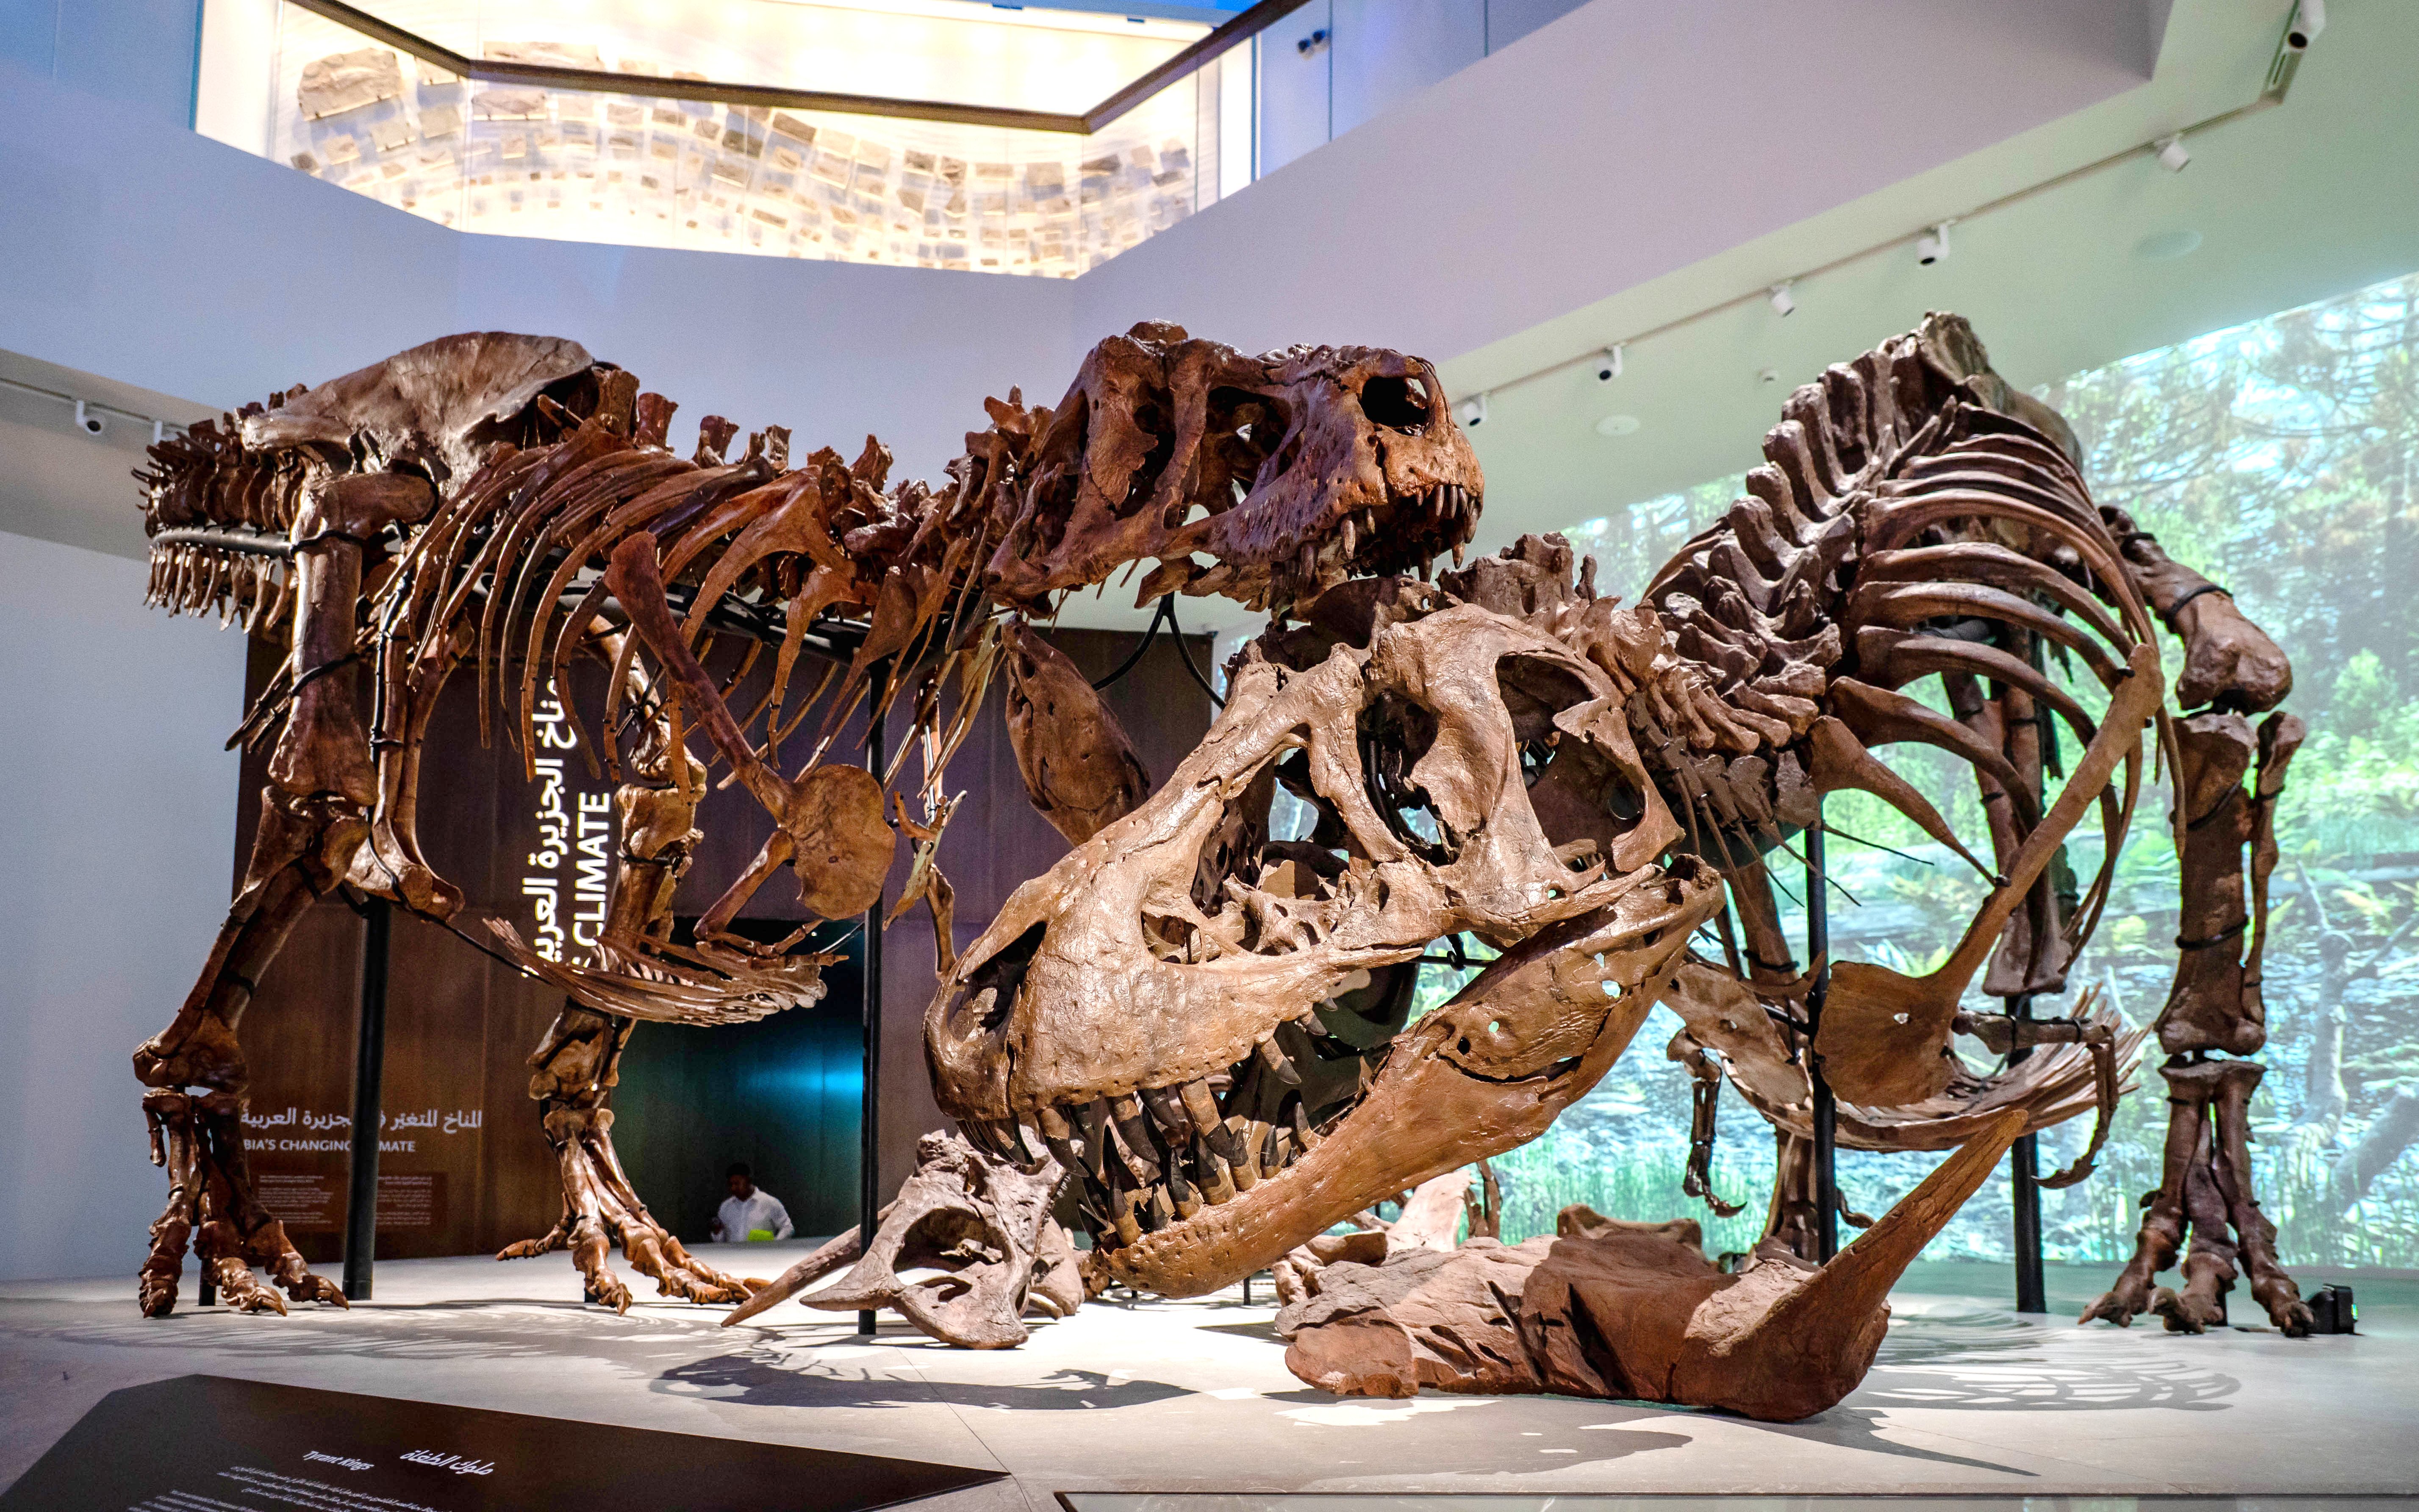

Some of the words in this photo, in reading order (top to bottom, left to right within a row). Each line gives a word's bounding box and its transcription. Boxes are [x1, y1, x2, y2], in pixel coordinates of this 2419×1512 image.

[527, 758, 569, 869] الجزيرة
[572, 792, 610, 947] CLIMATE
[521, 877, 564, 978] العربي
[240, 1106, 297, 1129] العربية
[302, 1110, 352, 1130] جزيرة
[443, 1108, 482, 1134] المناخ
[243, 1138, 276, 1151] BIA'S
[379, 1140, 416, 1152] MATE
[302, 1450, 342, 1464] Tyrant
[340, 1457, 375, 1471] Kings
[399, 1449, 461, 1466] الطغاة
[449, 1459, 495, 1475] ملوك
